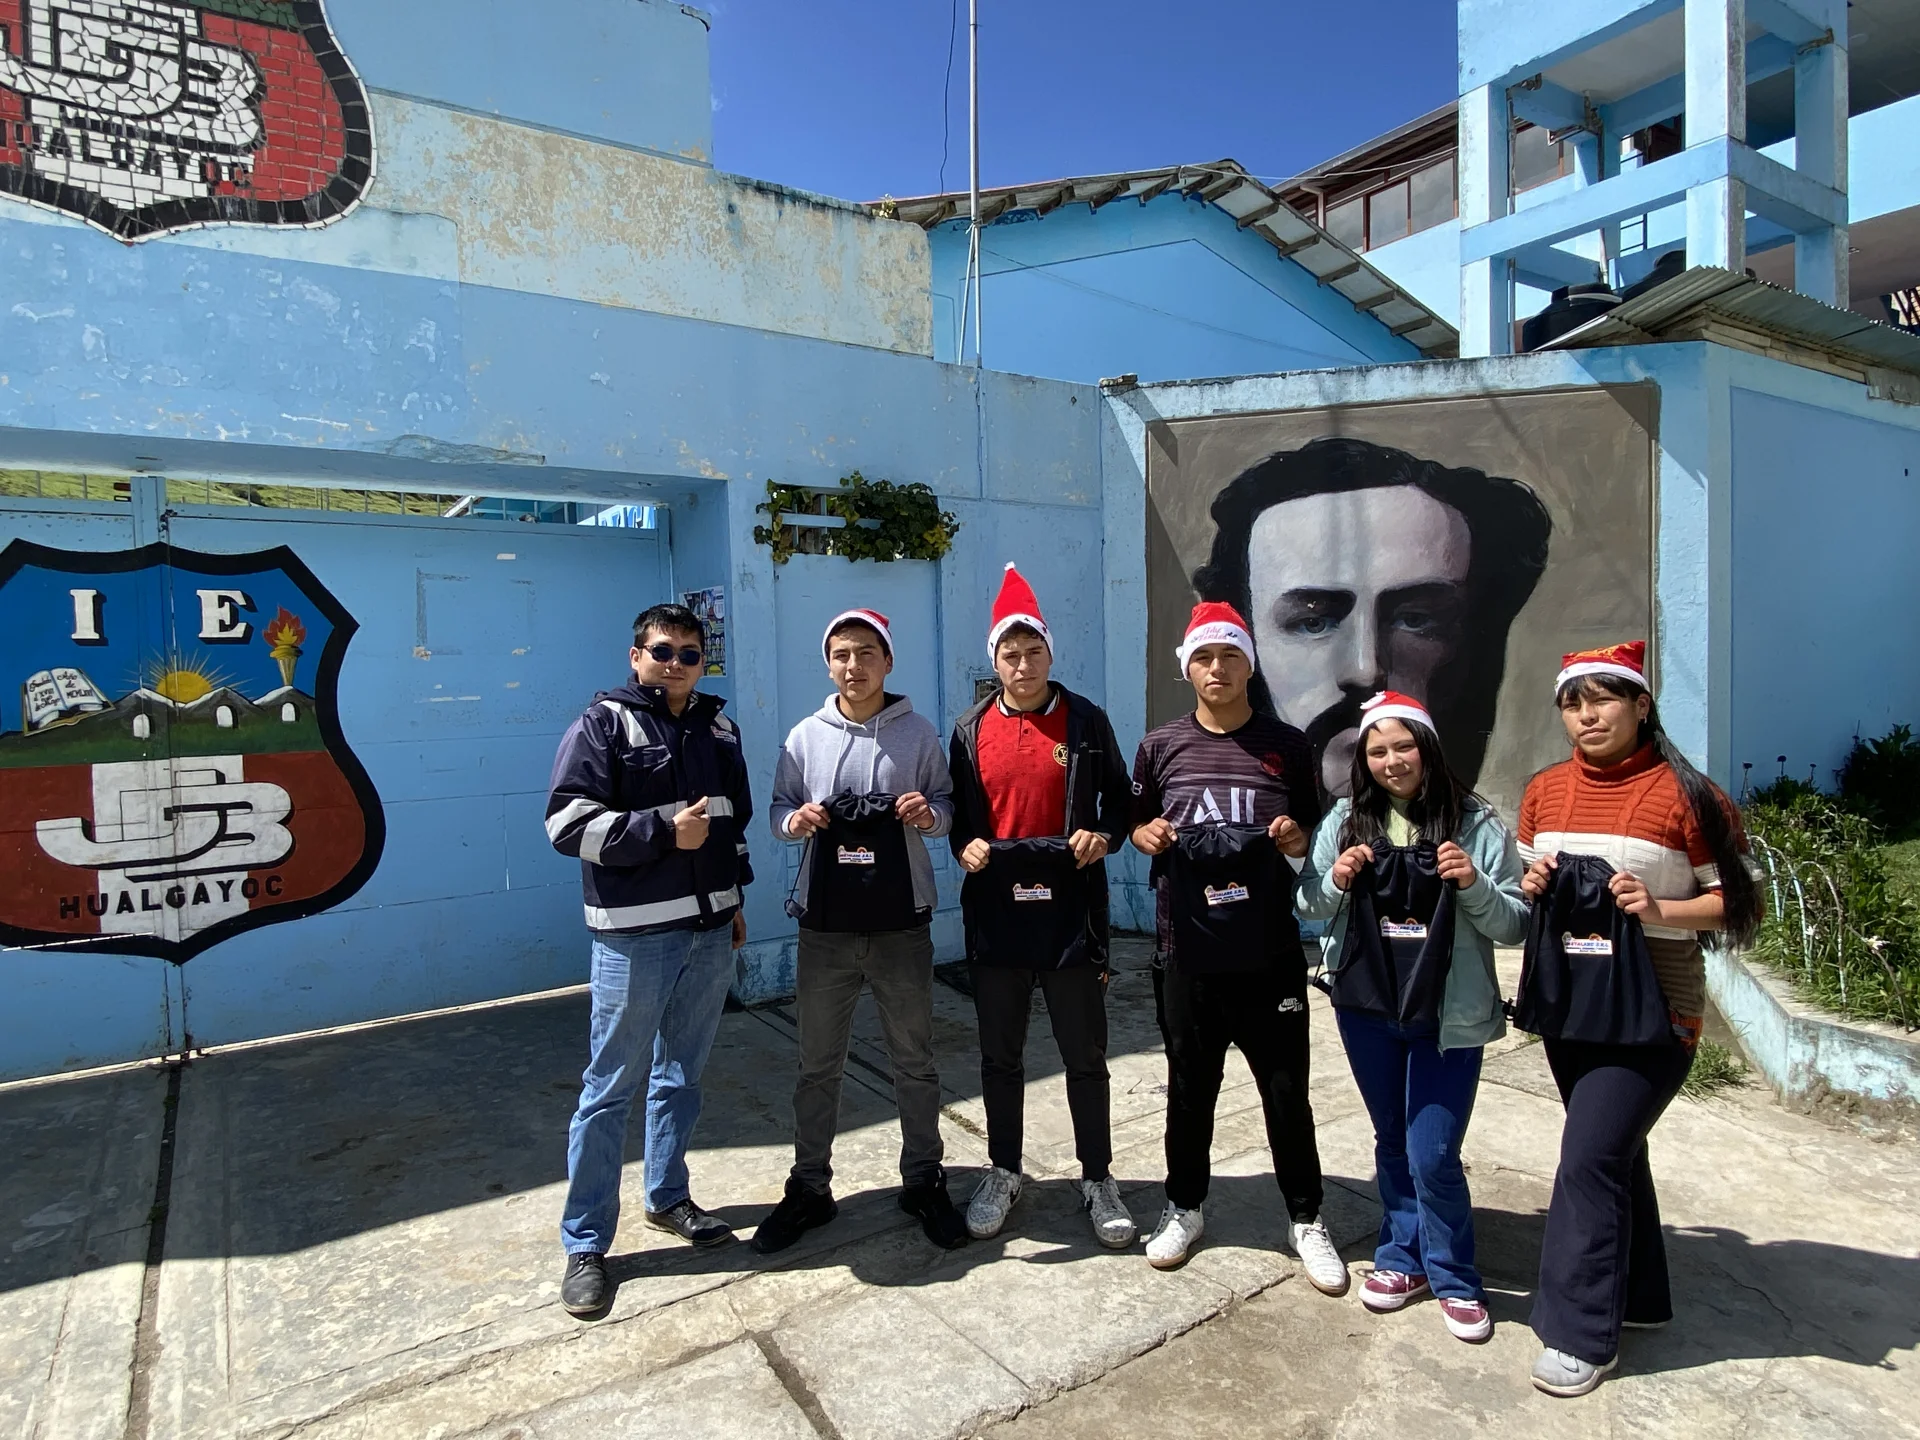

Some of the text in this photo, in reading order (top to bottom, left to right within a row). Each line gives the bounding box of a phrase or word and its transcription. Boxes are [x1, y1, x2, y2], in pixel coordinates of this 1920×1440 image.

[69, 589, 248, 641] I E
[59, 875, 284, 920] HUALGAYOC
